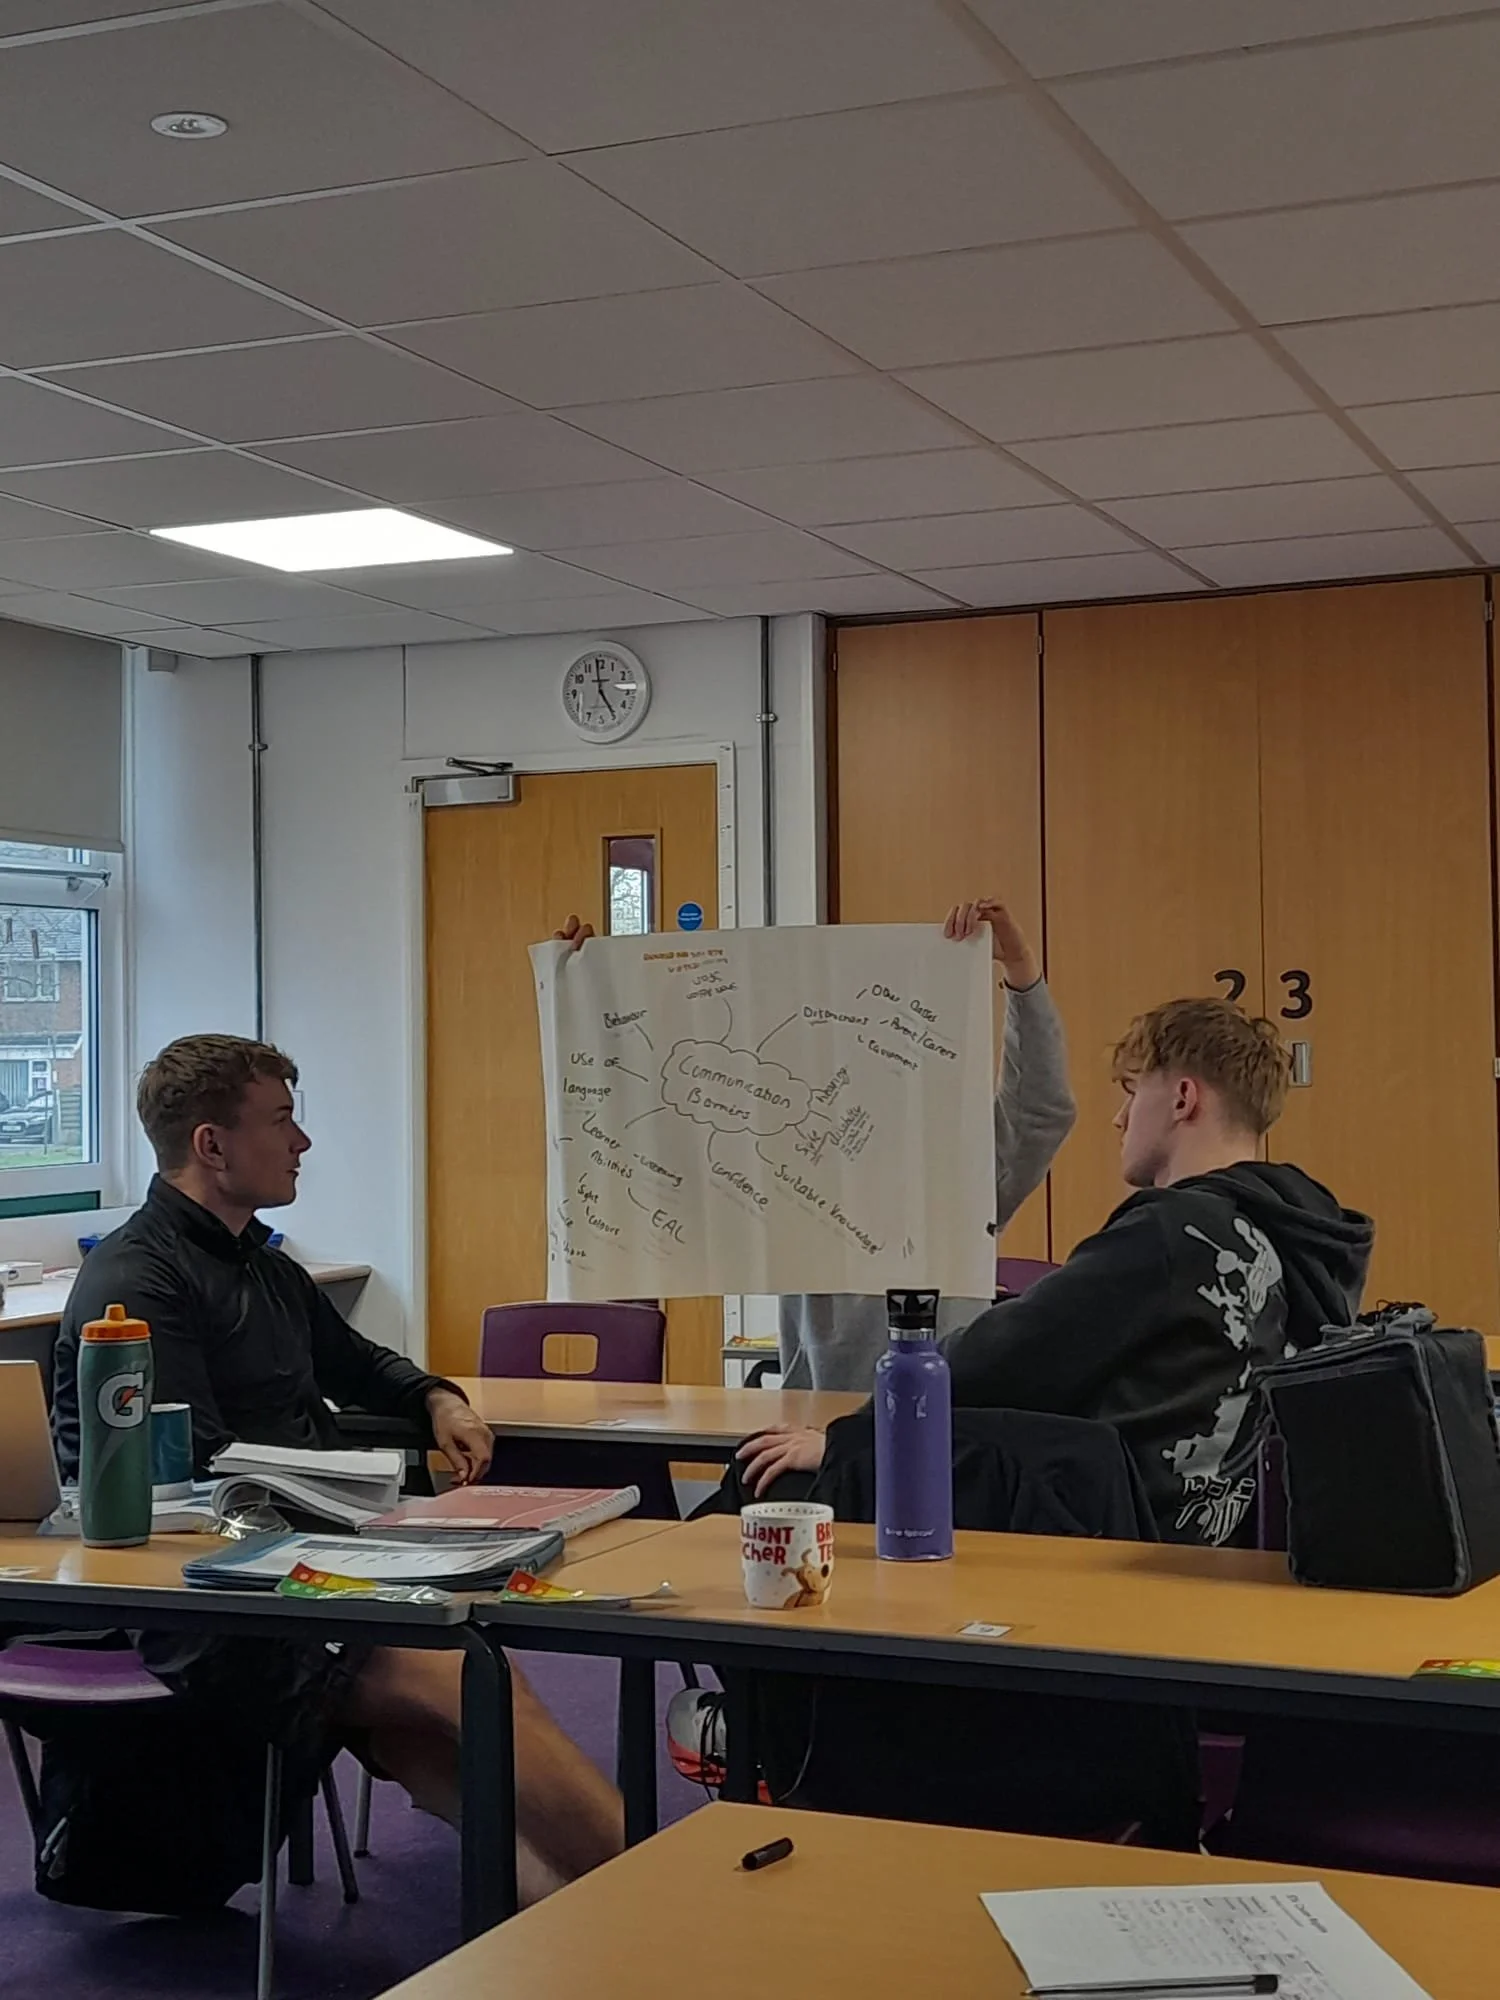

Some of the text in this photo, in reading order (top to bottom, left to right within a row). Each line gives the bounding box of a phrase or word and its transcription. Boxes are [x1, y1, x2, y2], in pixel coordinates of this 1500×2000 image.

[575, 674, 584, 684] 10
[620, 671, 626, 681] 2
[571, 689, 577, 699] 9
[586, 712, 592, 721] 7
[1214, 969, 1245, 1002] 2
[1279, 969, 1312, 1019] 3
[679, 1054, 792, 1109] Communication
[651, 1208, 686, 1244] EAL
[95, 1370, 145, 1429] G
